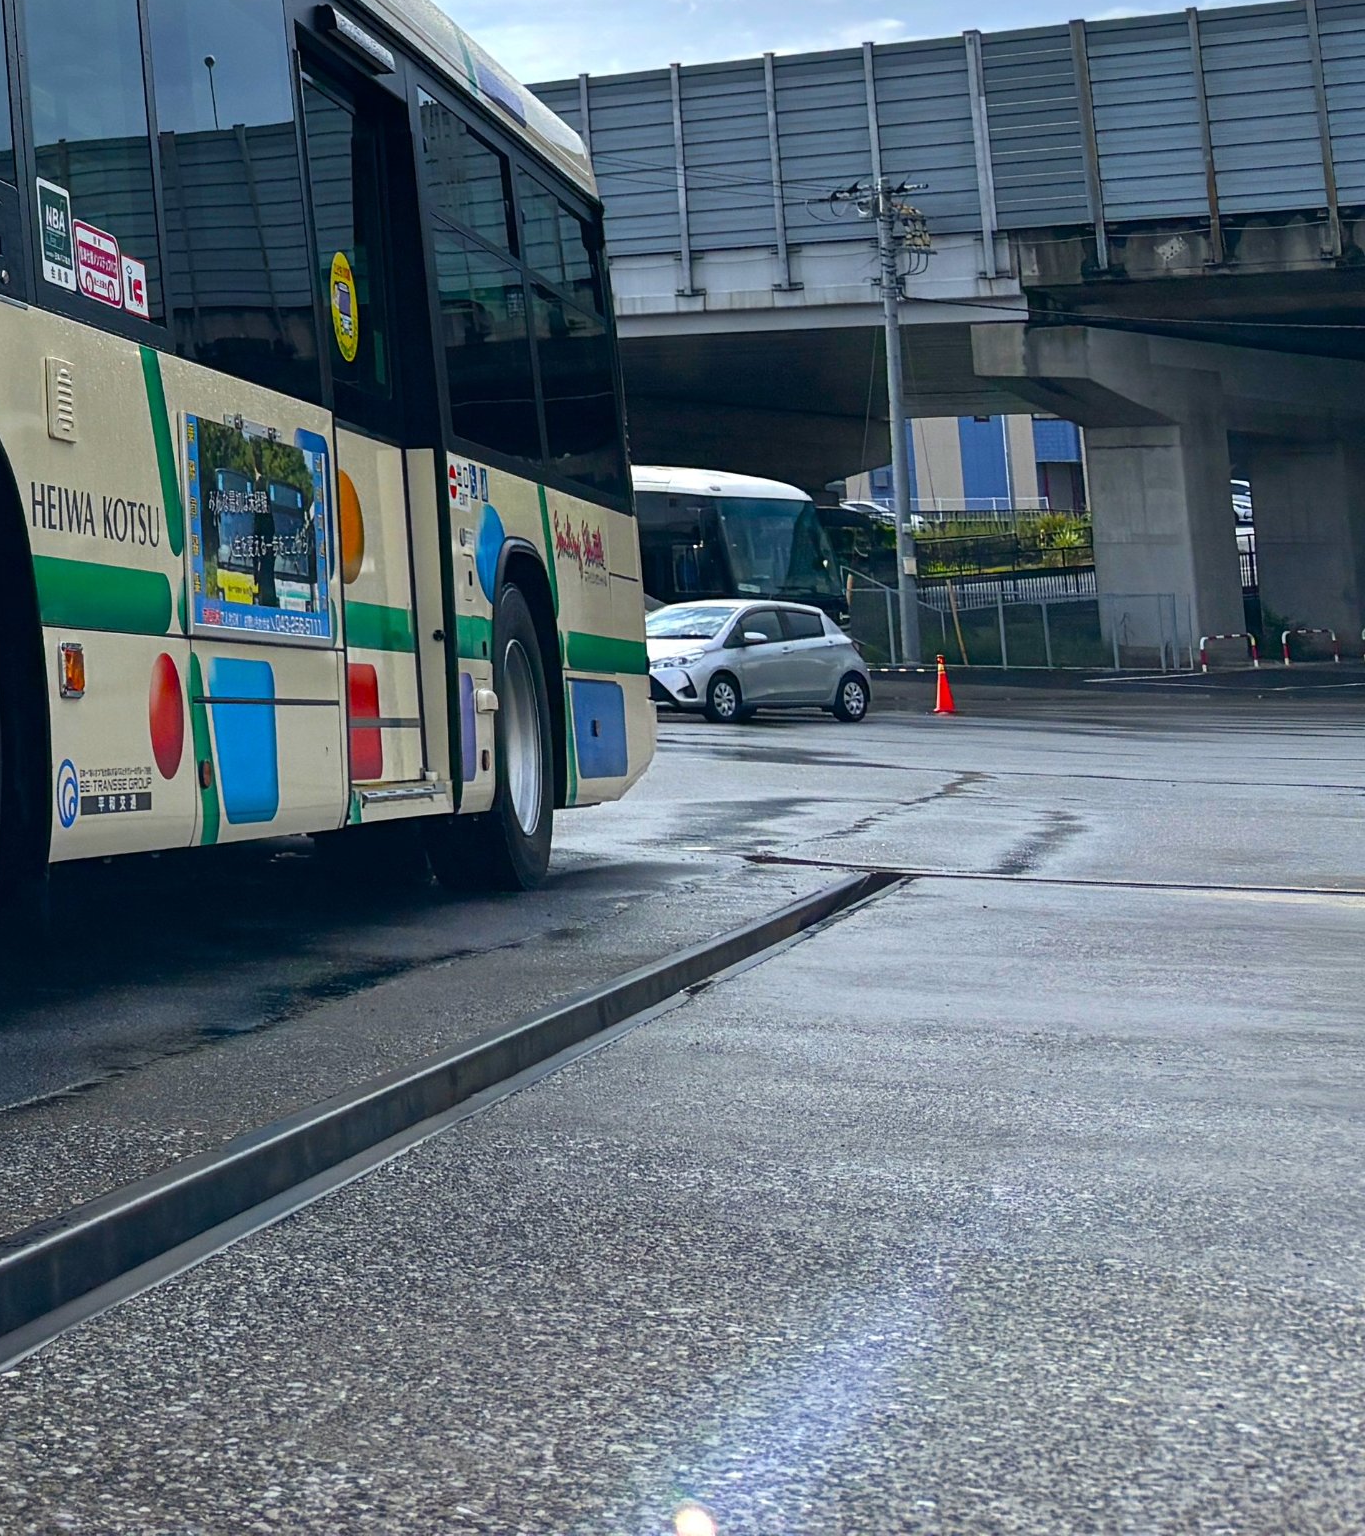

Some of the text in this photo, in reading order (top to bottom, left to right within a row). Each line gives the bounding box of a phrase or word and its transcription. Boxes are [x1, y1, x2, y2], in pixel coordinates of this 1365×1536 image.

[46, 204, 66, 232] NBA
[31, 481, 160, 548] HEIWA KOTSU
[129, 777, 152, 790] GROUP
